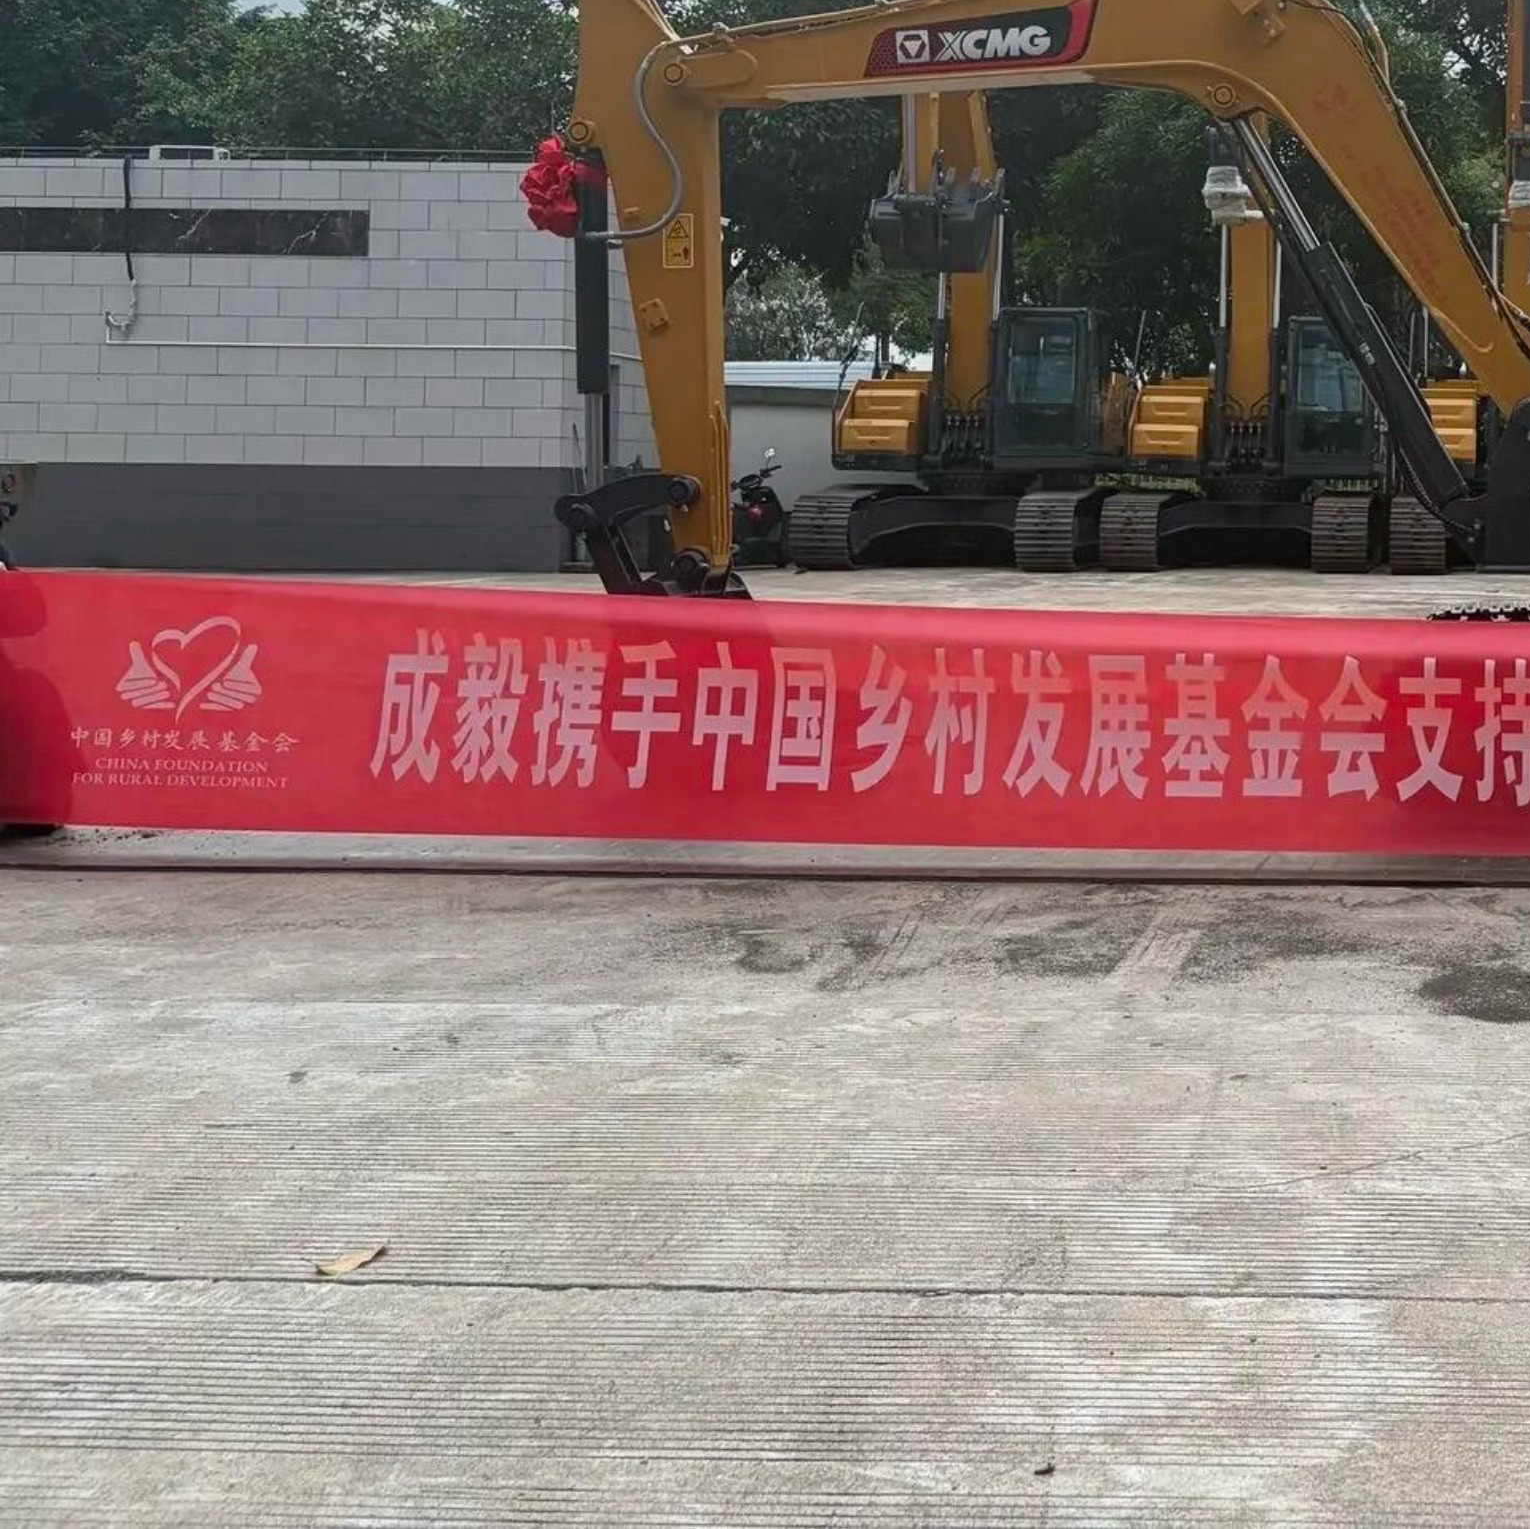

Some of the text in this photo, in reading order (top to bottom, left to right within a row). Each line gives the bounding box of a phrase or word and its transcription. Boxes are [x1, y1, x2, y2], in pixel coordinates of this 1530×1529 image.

[934, 25, 1051, 62] XCMG
[70, 726, 299, 752] 中国乡村发展基金会
[95, 757, 269, 773] CHINA FOUNDATION
[72, 773, 289, 789] FOR RURAL DEVELOPMENT
